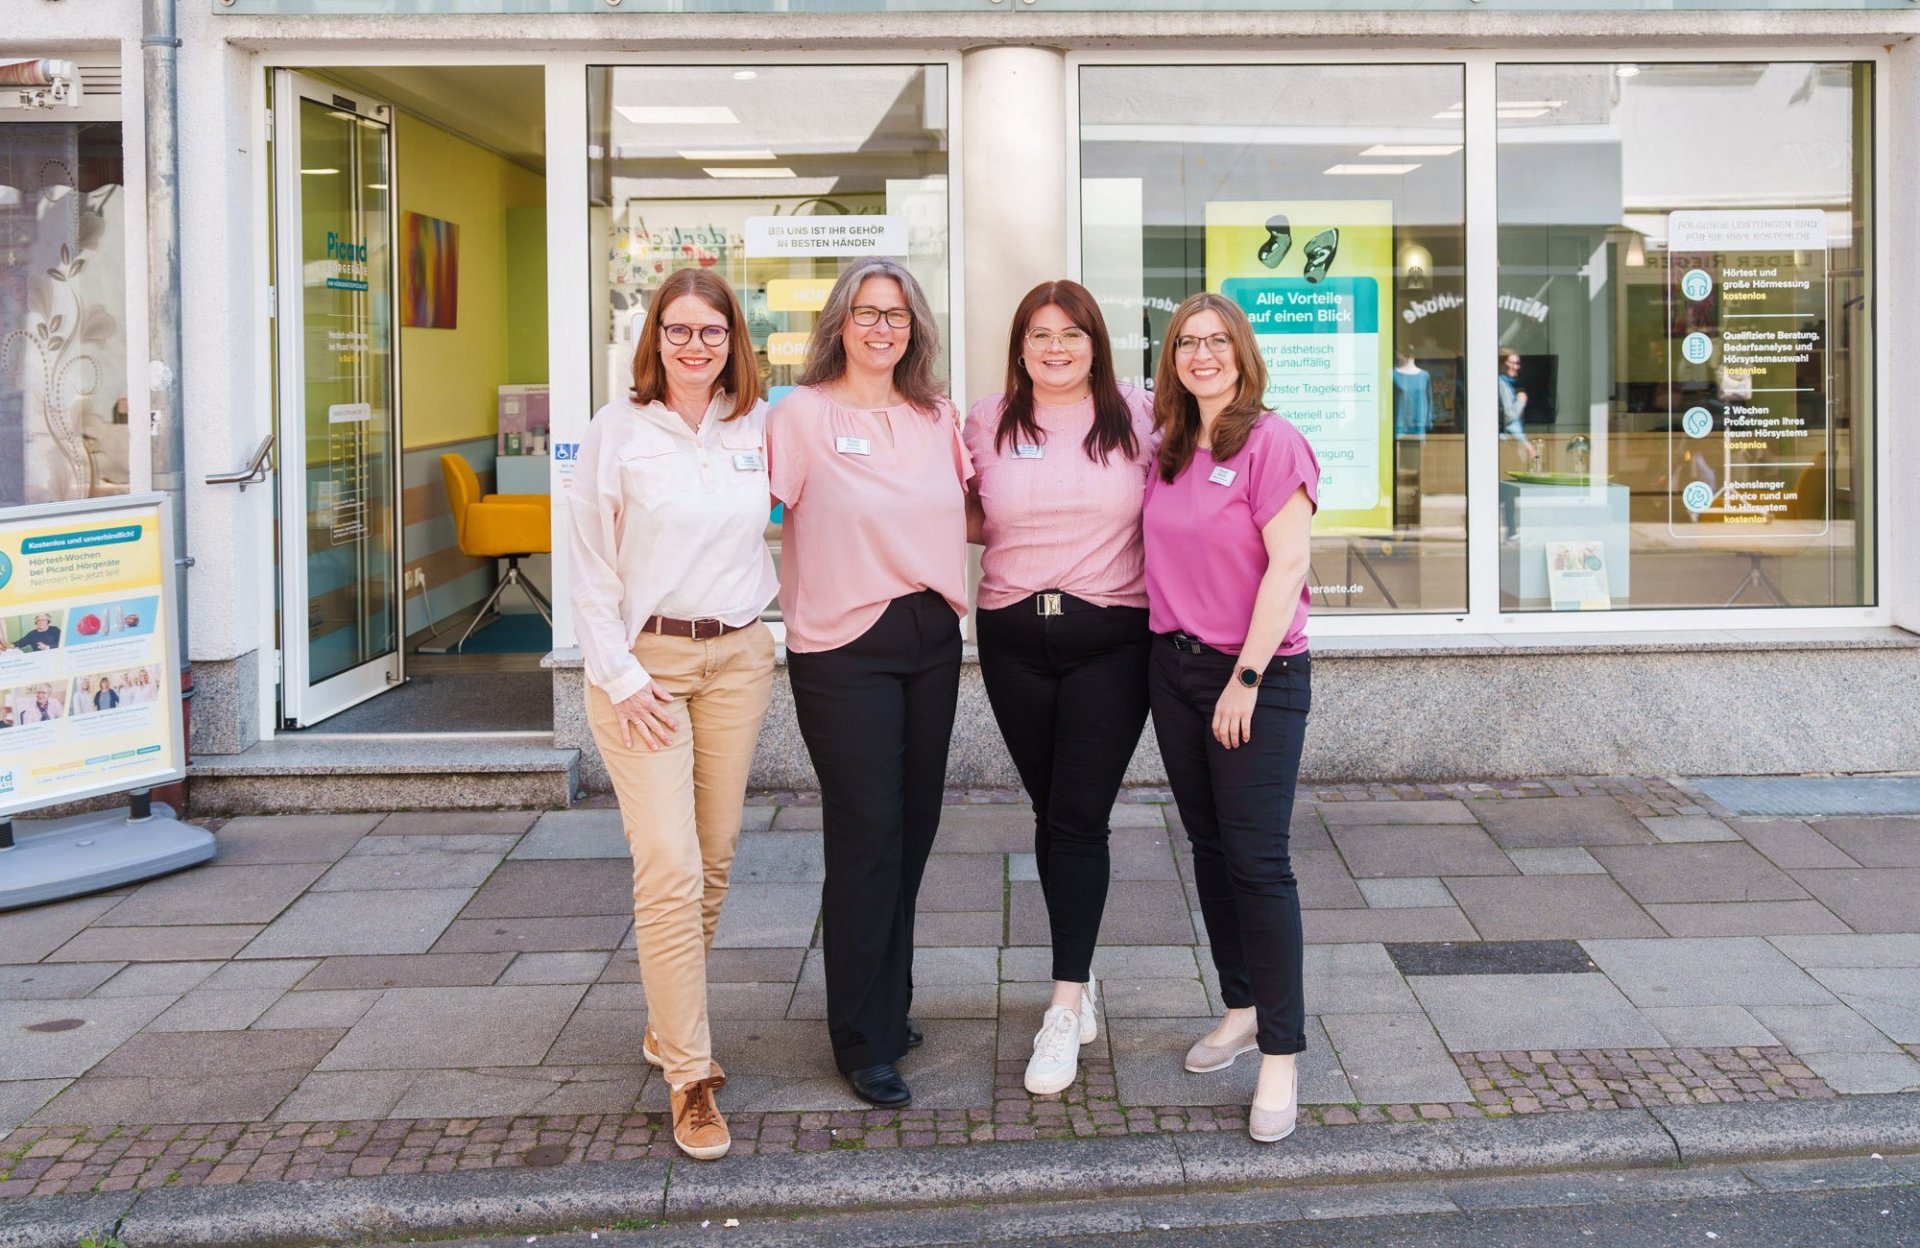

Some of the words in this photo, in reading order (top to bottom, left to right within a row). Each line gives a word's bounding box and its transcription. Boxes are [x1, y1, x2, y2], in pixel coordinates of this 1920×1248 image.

[768, 227, 785, 236] BEI
[787, 227, 808, 235] UNS
[811, 226, 826, 235] IST
[829, 226, 846, 235] IHR
[849, 224, 884, 235] GEHÖR
[1731, 220, 1792, 230] LEISTUNGEN
[1794, 219, 1817, 229] SIND
[777, 239, 788, 248] IN
[791, 239, 830, 248] BESTEN
[832, 236, 876, 248] HÄNDEN
[1686, 231, 1705, 242] FÜR
[1708, 233, 1723, 241] SIE
[1753, 231, 1809, 241] KOSTENLOS
[1723, 268, 1757, 277] Hörtest
[1760, 268, 1777, 277] und
[1723, 281, 1750, 290] große
[1753, 279, 1810, 290] Hörmessung
[1256, 292, 1283, 305] Alle
[1287, 291, 1342, 305] Vorteile
[1723, 292, 1766, 300] kostenlos
[1248, 310, 1271, 323] auf
[1274, 310, 1313, 322] einen
[1317, 309, 1352, 321] Blick
[1723, 331, 1776, 341] Qualifizierte
[1777, 330, 1820, 341] Beratung,
[1260, 345, 1277, 354] ehr
[1280, 344, 1334, 354] ästhetisch
[1723, 342, 1793, 353] Bedarfsanalyse
[1795, 342, 1813, 351] und
[1277, 358, 1331, 369] unauffällig
[1723, 354, 1809, 364] Hörsystemauswahl
[1724, 366, 1767, 375] kostenlos
[1267, 384, 1299, 394] chster
[1302, 383, 1370, 395] Tragekomfort
[1282, 411, 1322, 420] akteriell
[1325, 410, 1345, 420] und
[1723, 406, 1730, 415] 2
[1732, 406, 1769, 415] Wochen
[1723, 417, 1780, 427] Probetragen
[1782, 417, 1805, 426] Ihres
[1724, 430, 1752, 438] neuen
[1754, 429, 1808, 439] Hörsystems
[1724, 441, 1767, 449] kostenlos
[1316, 449, 1354, 460] inigung
[1724, 480, 1785, 490] Lebenslanger
[1724, 492, 1757, 500] Service
[1760, 491, 1781, 500] rund
[1739, 503, 1787, 513] Hörsystem
[1724, 515, 1767, 524] kostenlos
[28, 539, 66, 550] Kostenlos
[67, 536, 82, 545] und
[83, 530, 135, 543] unverbindlich!
[29, 552, 101, 567] Hörtest-Wochen
[30, 568, 44, 577] bei
[46, 564, 74, 574] Picard
[76, 559, 120, 570] Hörgeräte
